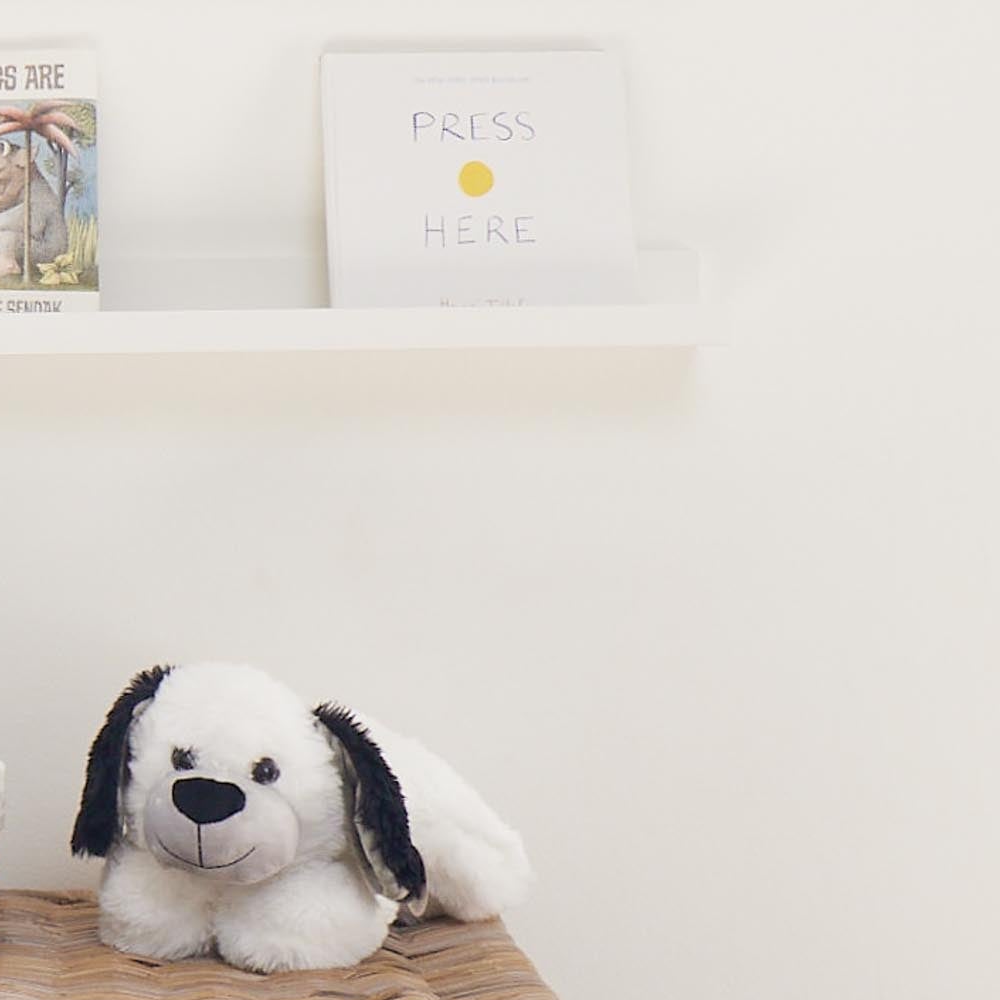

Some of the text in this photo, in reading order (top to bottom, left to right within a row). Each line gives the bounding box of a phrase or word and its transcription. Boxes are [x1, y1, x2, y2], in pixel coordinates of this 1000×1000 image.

[24, 64, 65, 90] ARE
[412, 111, 536, 142] PRESS
[424, 212, 537, 248] HERE
